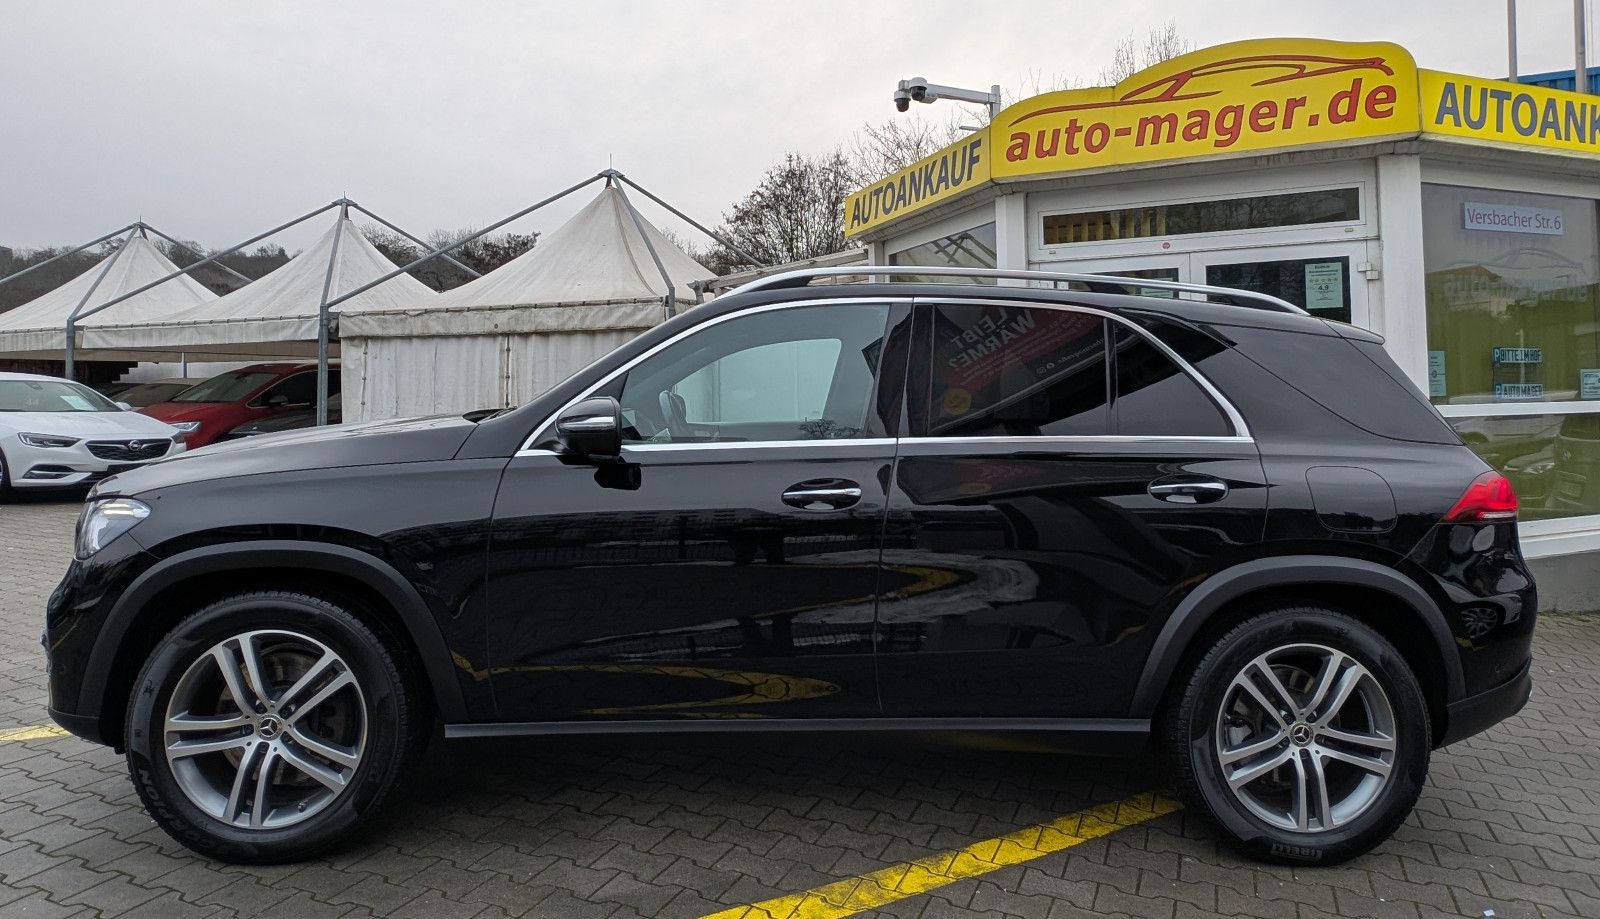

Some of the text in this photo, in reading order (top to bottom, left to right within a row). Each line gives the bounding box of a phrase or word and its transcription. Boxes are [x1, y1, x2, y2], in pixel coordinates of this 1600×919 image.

[1005, 77, 1396, 163] auto-mager.de
[1435, 82, 1600, 145] AUTOANK
[850, 138, 982, 229] AUTOANKAUF
[1467, 207, 1532, 228] Versbacher
